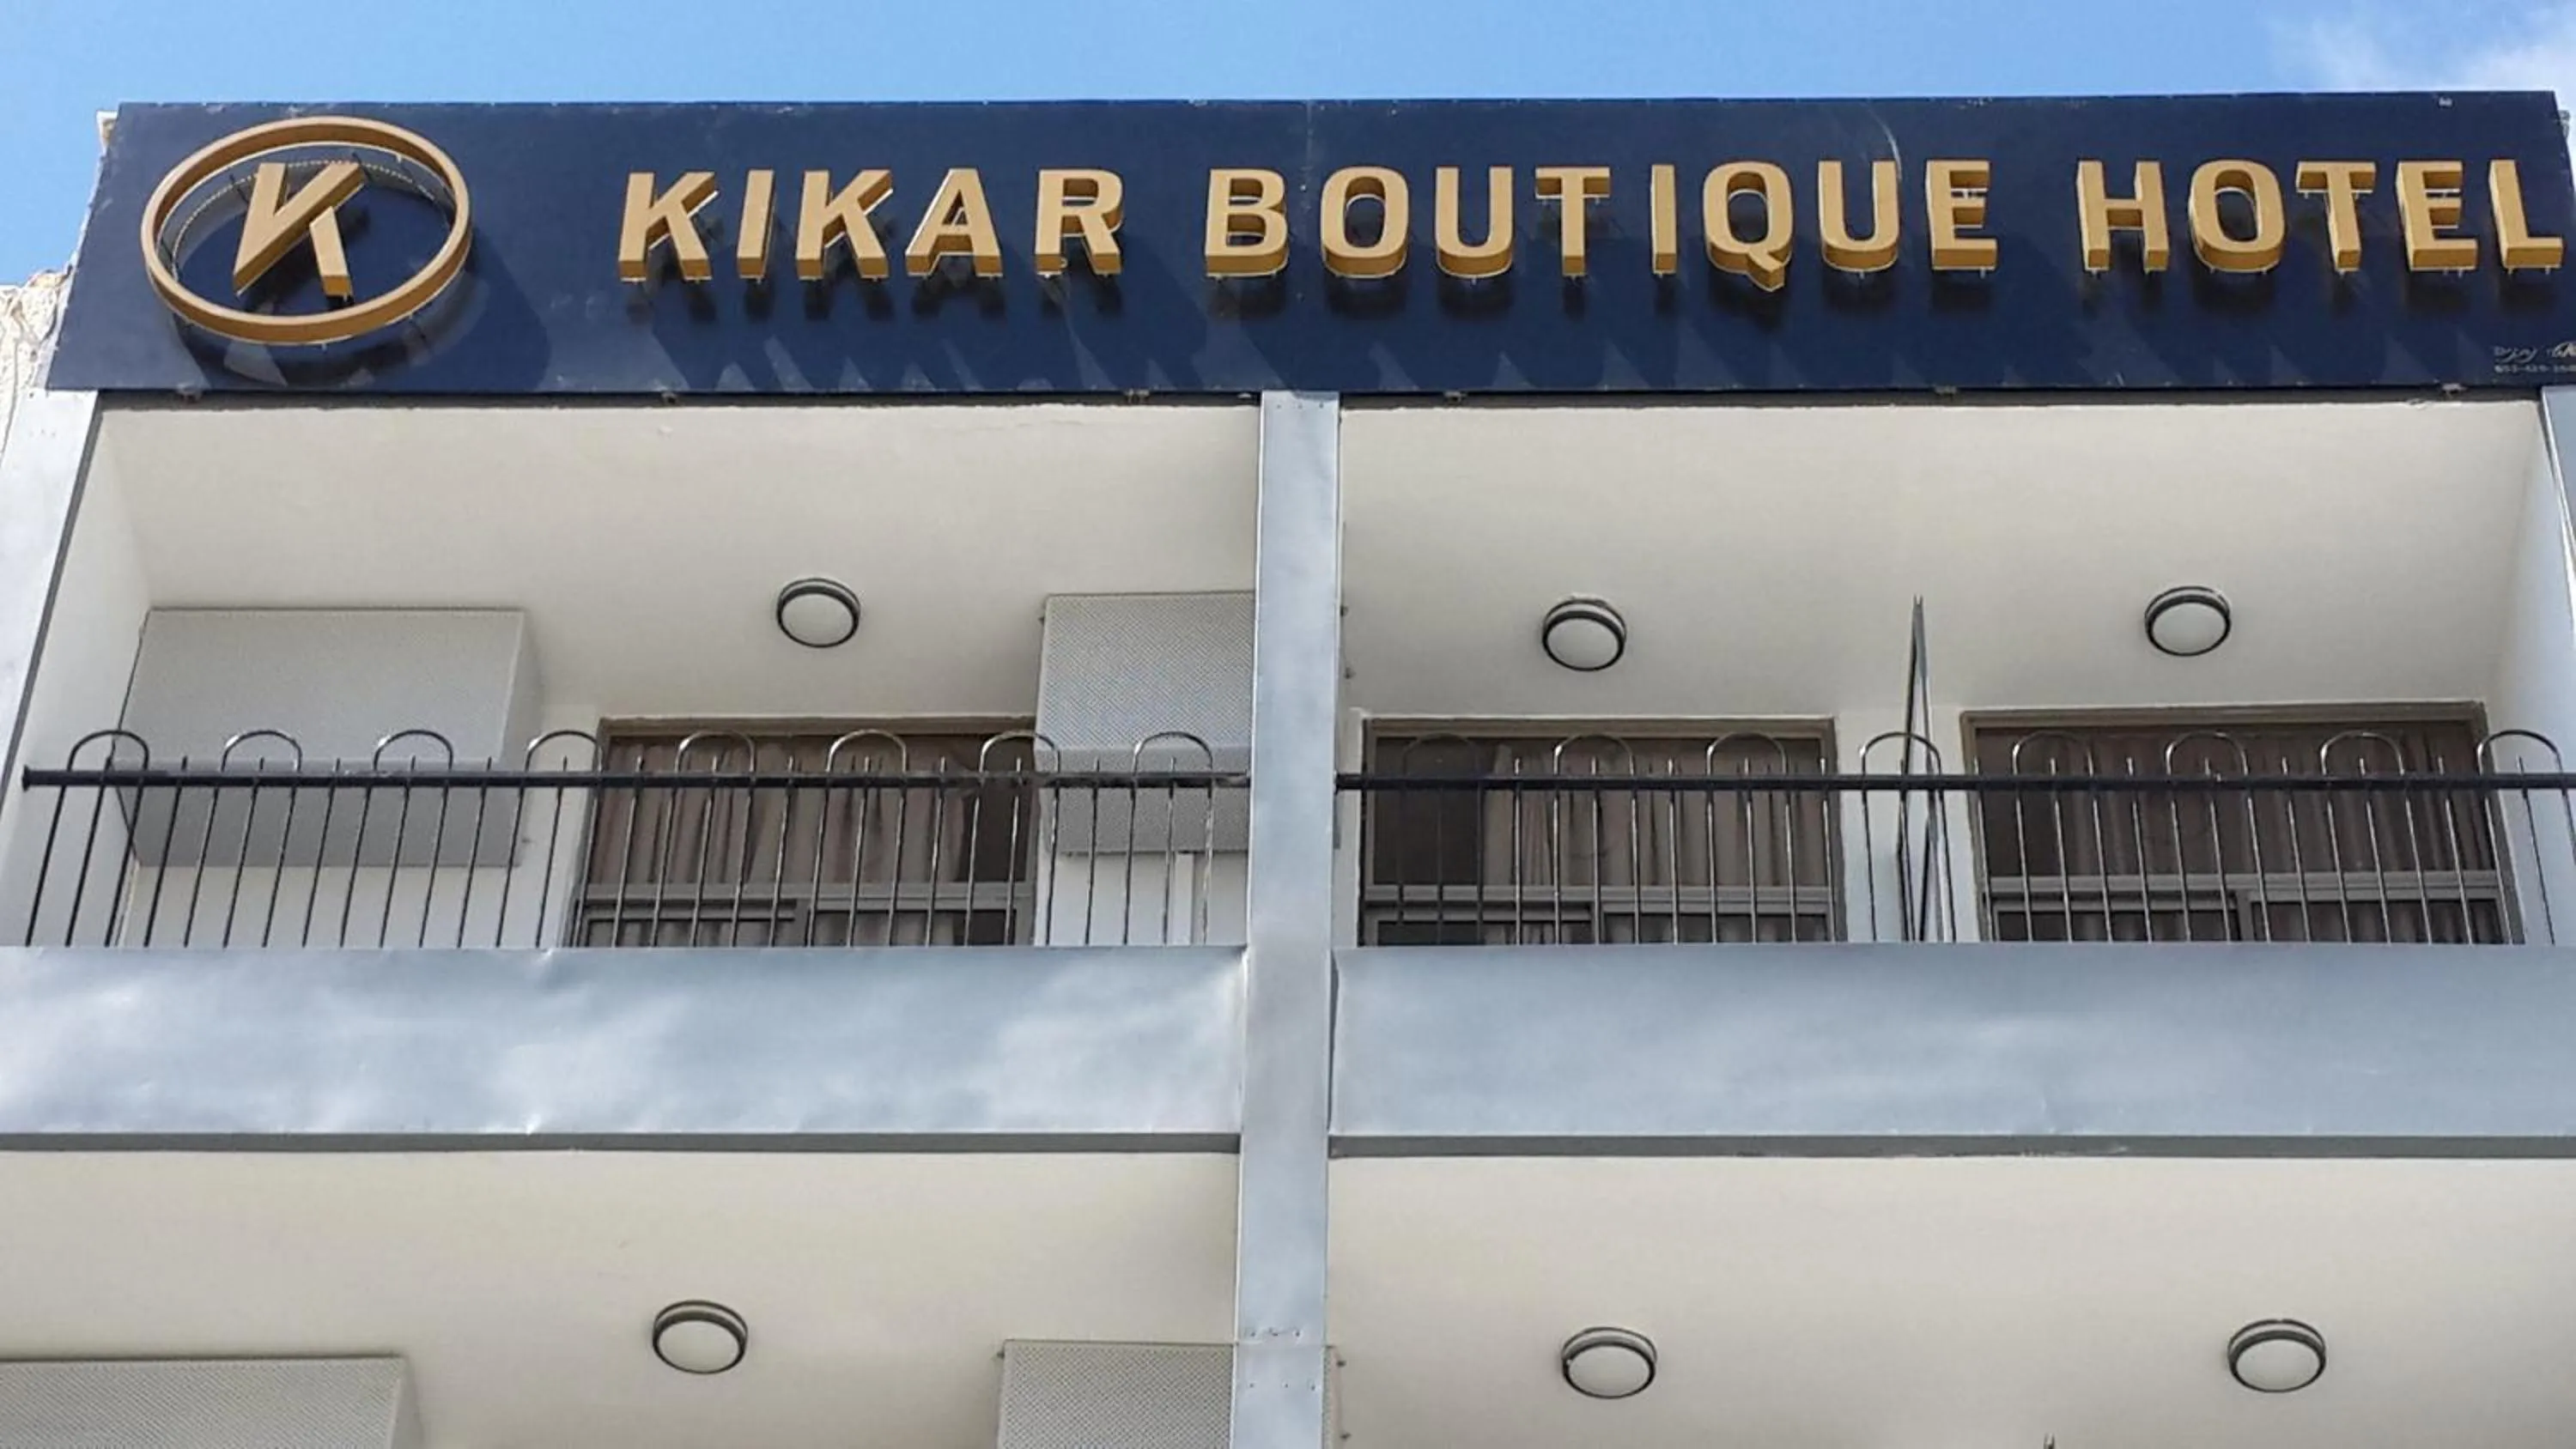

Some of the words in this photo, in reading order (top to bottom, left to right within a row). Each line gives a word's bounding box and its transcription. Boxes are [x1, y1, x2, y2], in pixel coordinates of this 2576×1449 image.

[233, 161, 366, 302] K
[617, 167, 1124, 282] KIKAR
[1204, 160, 1999, 292] BOUTIQUE
[2075, 159, 2564, 274] HOTEL
